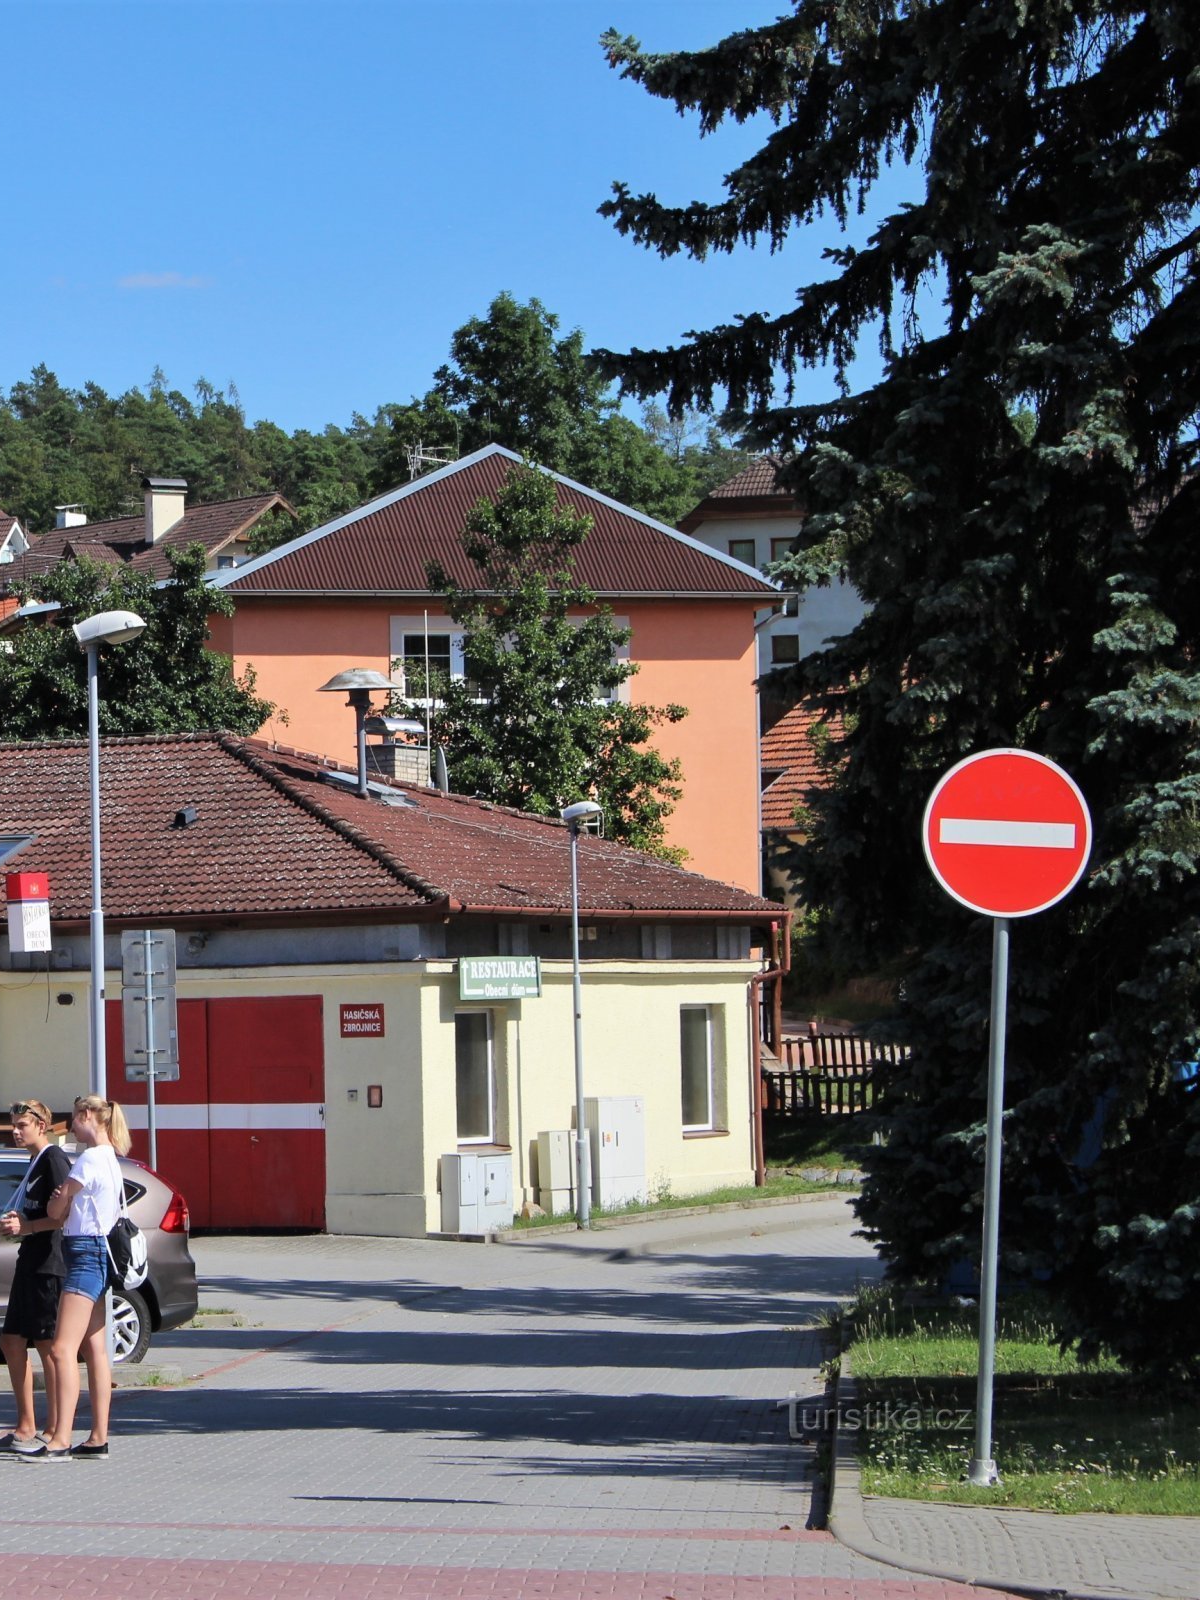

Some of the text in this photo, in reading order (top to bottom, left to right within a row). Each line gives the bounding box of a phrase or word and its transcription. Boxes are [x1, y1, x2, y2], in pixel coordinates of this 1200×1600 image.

[470, 960, 537, 978] RESTAURACE
[484, 983, 508, 997] Obecní
[343, 1008, 380, 1020] HASIČSKÁ
[343, 1023, 381, 1032] ZBROJNICE
